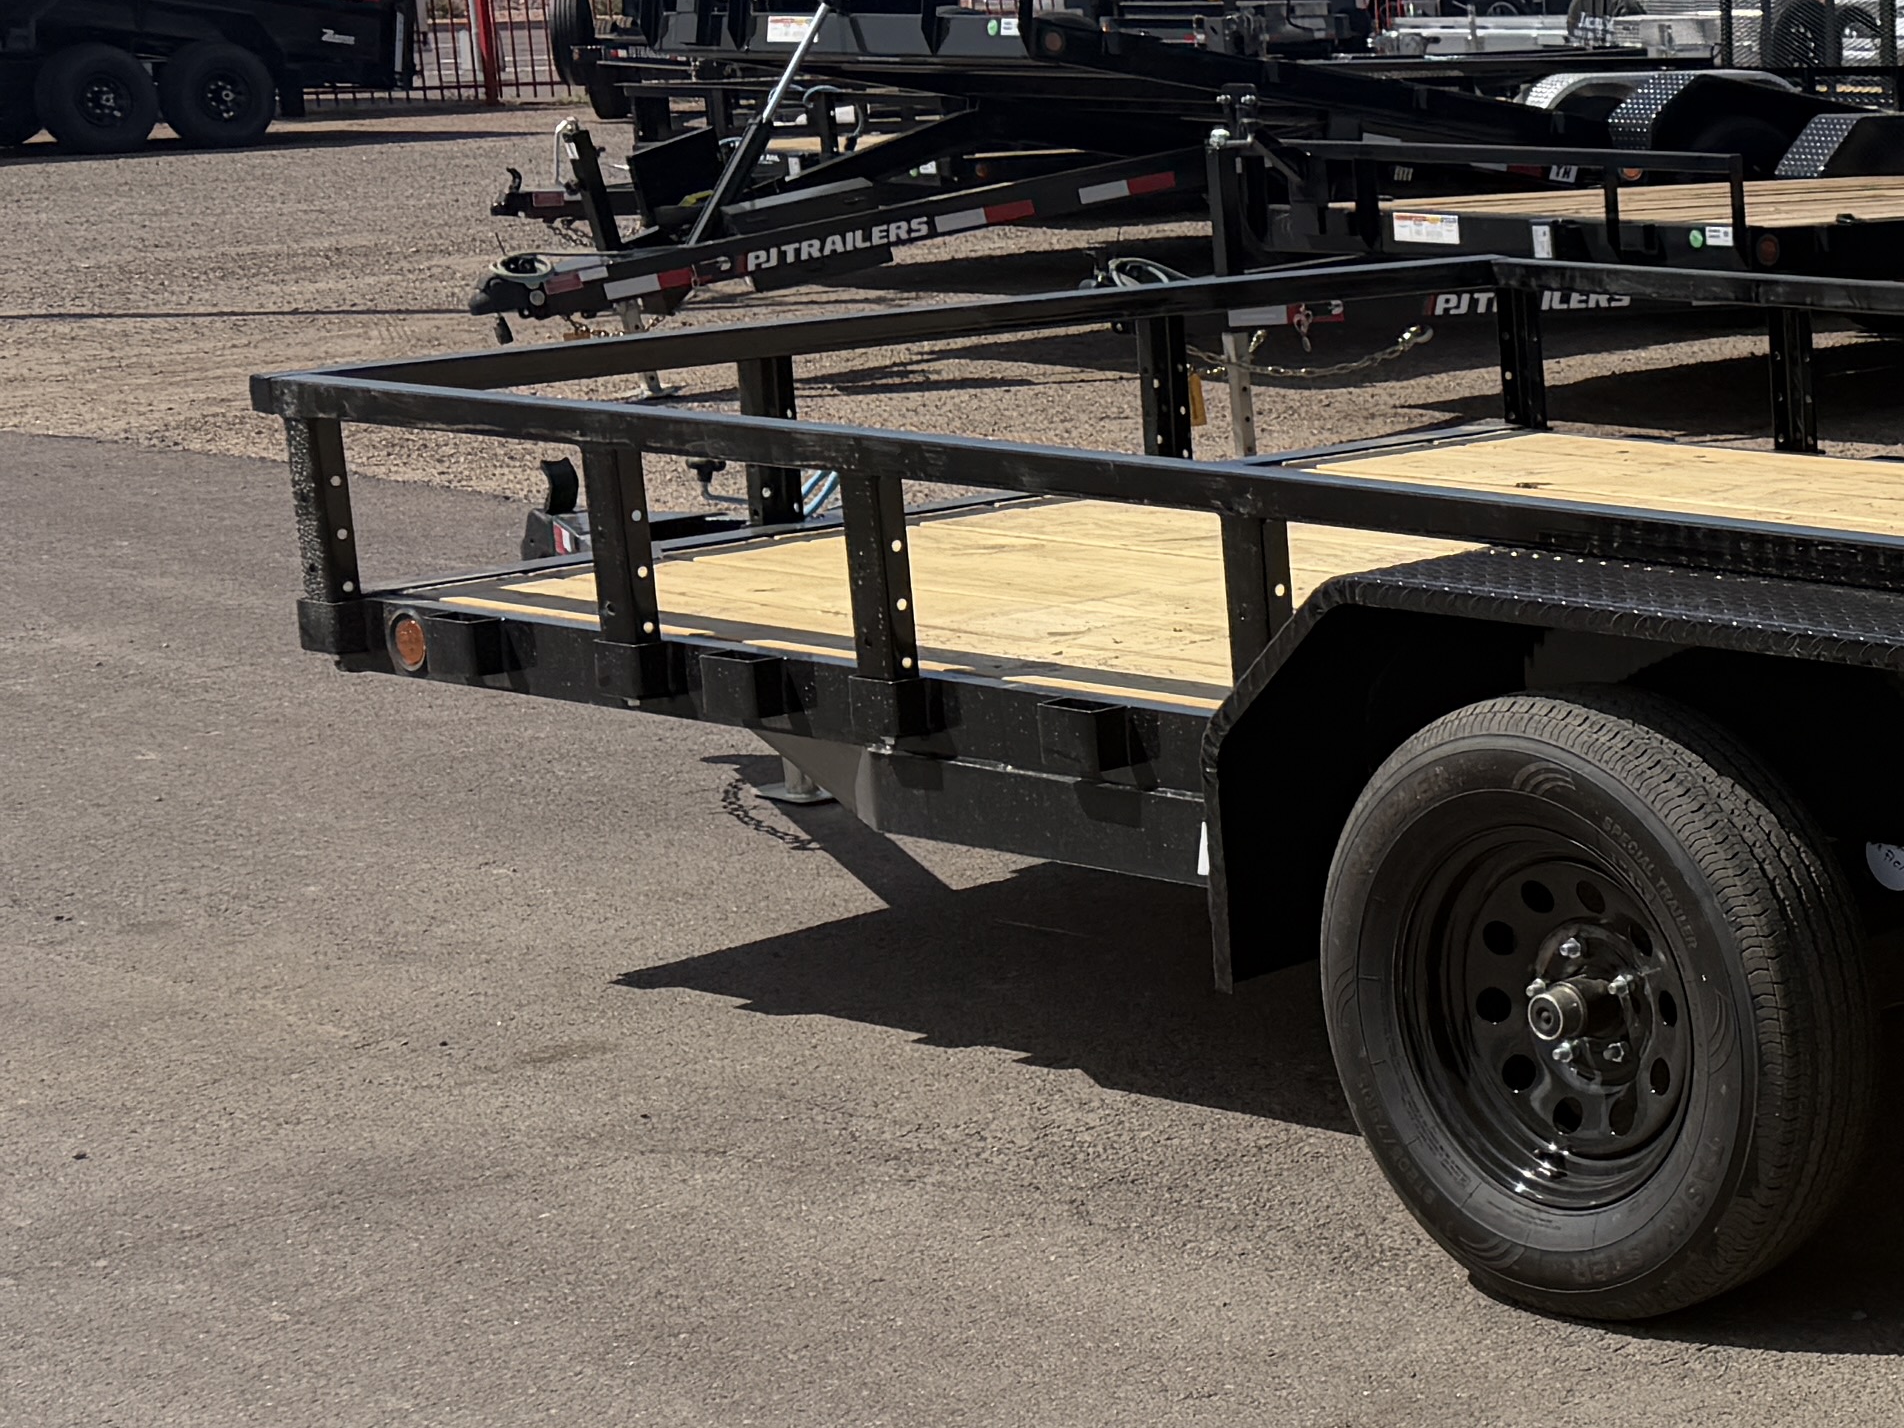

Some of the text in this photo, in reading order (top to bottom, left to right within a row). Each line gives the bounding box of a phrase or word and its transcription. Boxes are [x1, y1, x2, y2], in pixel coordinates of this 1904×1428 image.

[747, 216, 929, 272] PJ TRAILERS
[1434, 290, 1632, 316] PJ TILERS
[1601, 815, 1655, 875] SPECIAL
[1656, 876, 1698, 949] TRAILER
